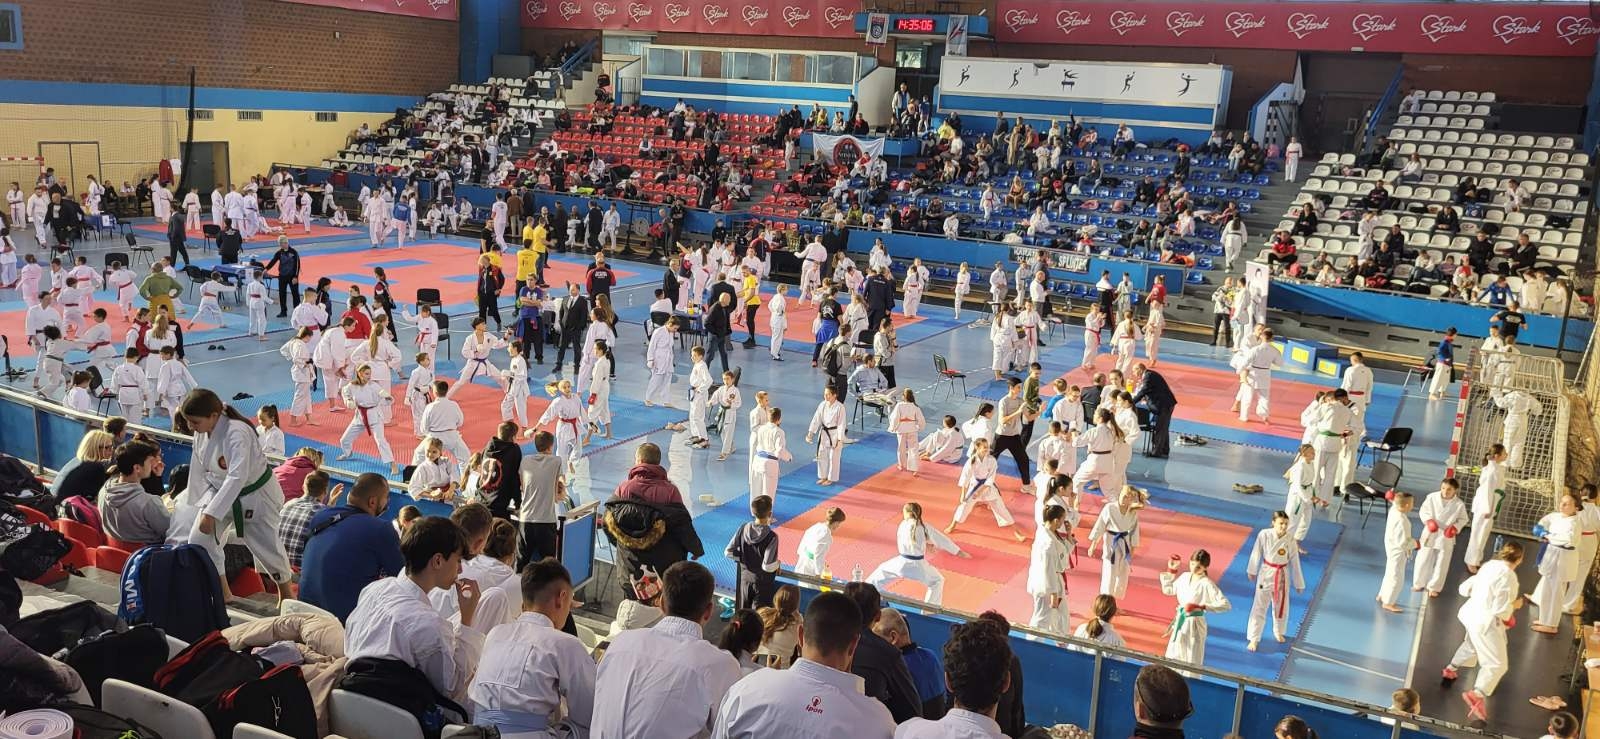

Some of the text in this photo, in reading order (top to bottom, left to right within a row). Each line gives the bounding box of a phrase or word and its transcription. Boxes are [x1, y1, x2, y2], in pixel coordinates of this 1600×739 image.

[531, 4, 548, 14] Stark
[564, 4, 582, 15] Stark
[599, 5, 616, 15] Stark
[633, 6, 652, 16] Stark
[670, 6, 690, 17] Stark
[708, 8, 729, 18] Stark
[748, 9, 769, 20] Stark
[789, 10, 811, 21] Stark
[831, 10, 854, 22] Stark
[1012, 13, 1039, 25] Stark
[1063, 13, 1091, 26] Stark
[1118, 14, 1147, 27] Stark
[1174, 15, 1205, 28] Stark
[898, 19, 933, 31] 14:35:06
[1233, 16, 1266, 29] Stark
[1296, 16, 1330, 30] Stark
[1361, 17, 1397, 32] Stark
[1430, 19, 1467, 33] Stark
[1503, 20, 1542, 34] Stark
[1567, 21, 1600, 36] Star
